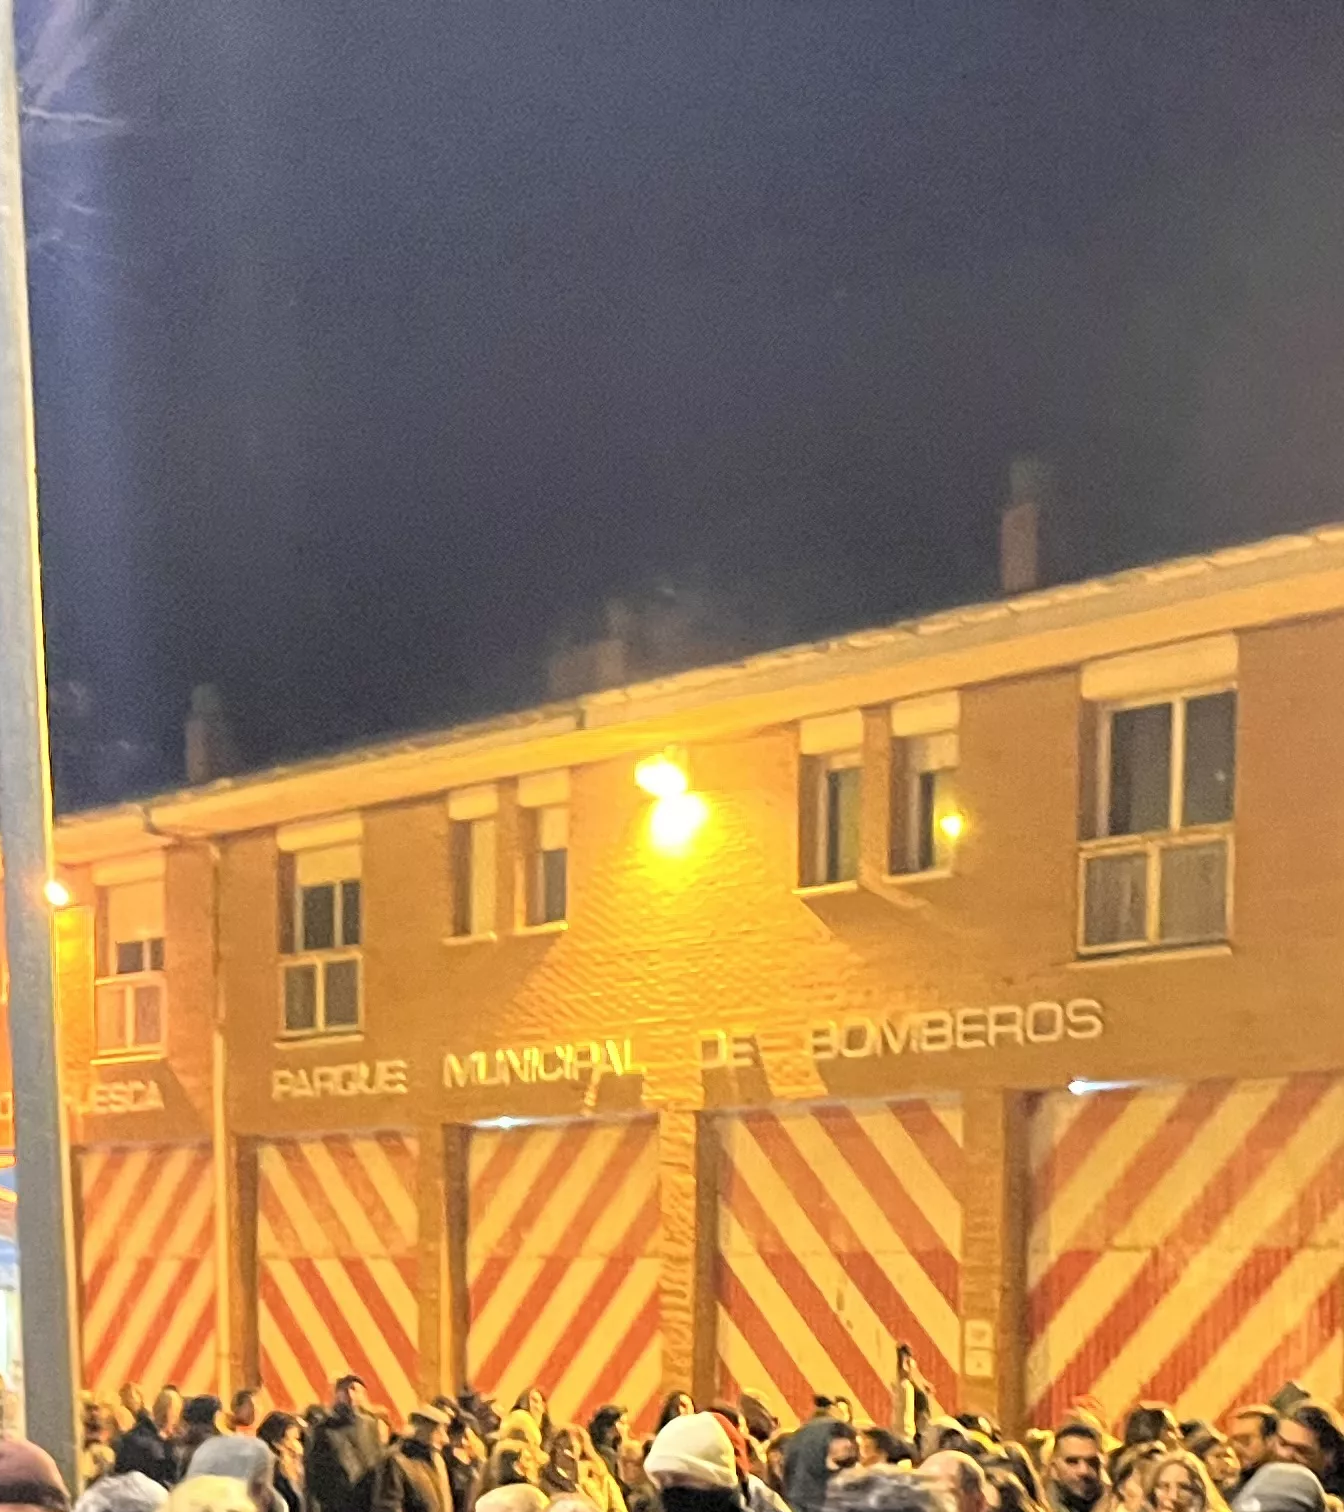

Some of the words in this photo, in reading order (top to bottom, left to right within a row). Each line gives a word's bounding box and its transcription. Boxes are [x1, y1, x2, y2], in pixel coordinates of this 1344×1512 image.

[271, 1060, 408, 1100] PARQUE
[442, 1038, 646, 1088] MUNICIPAL
[698, 1028, 755, 1070] DE
[808, 998, 1104, 1060] BOMBEROS
